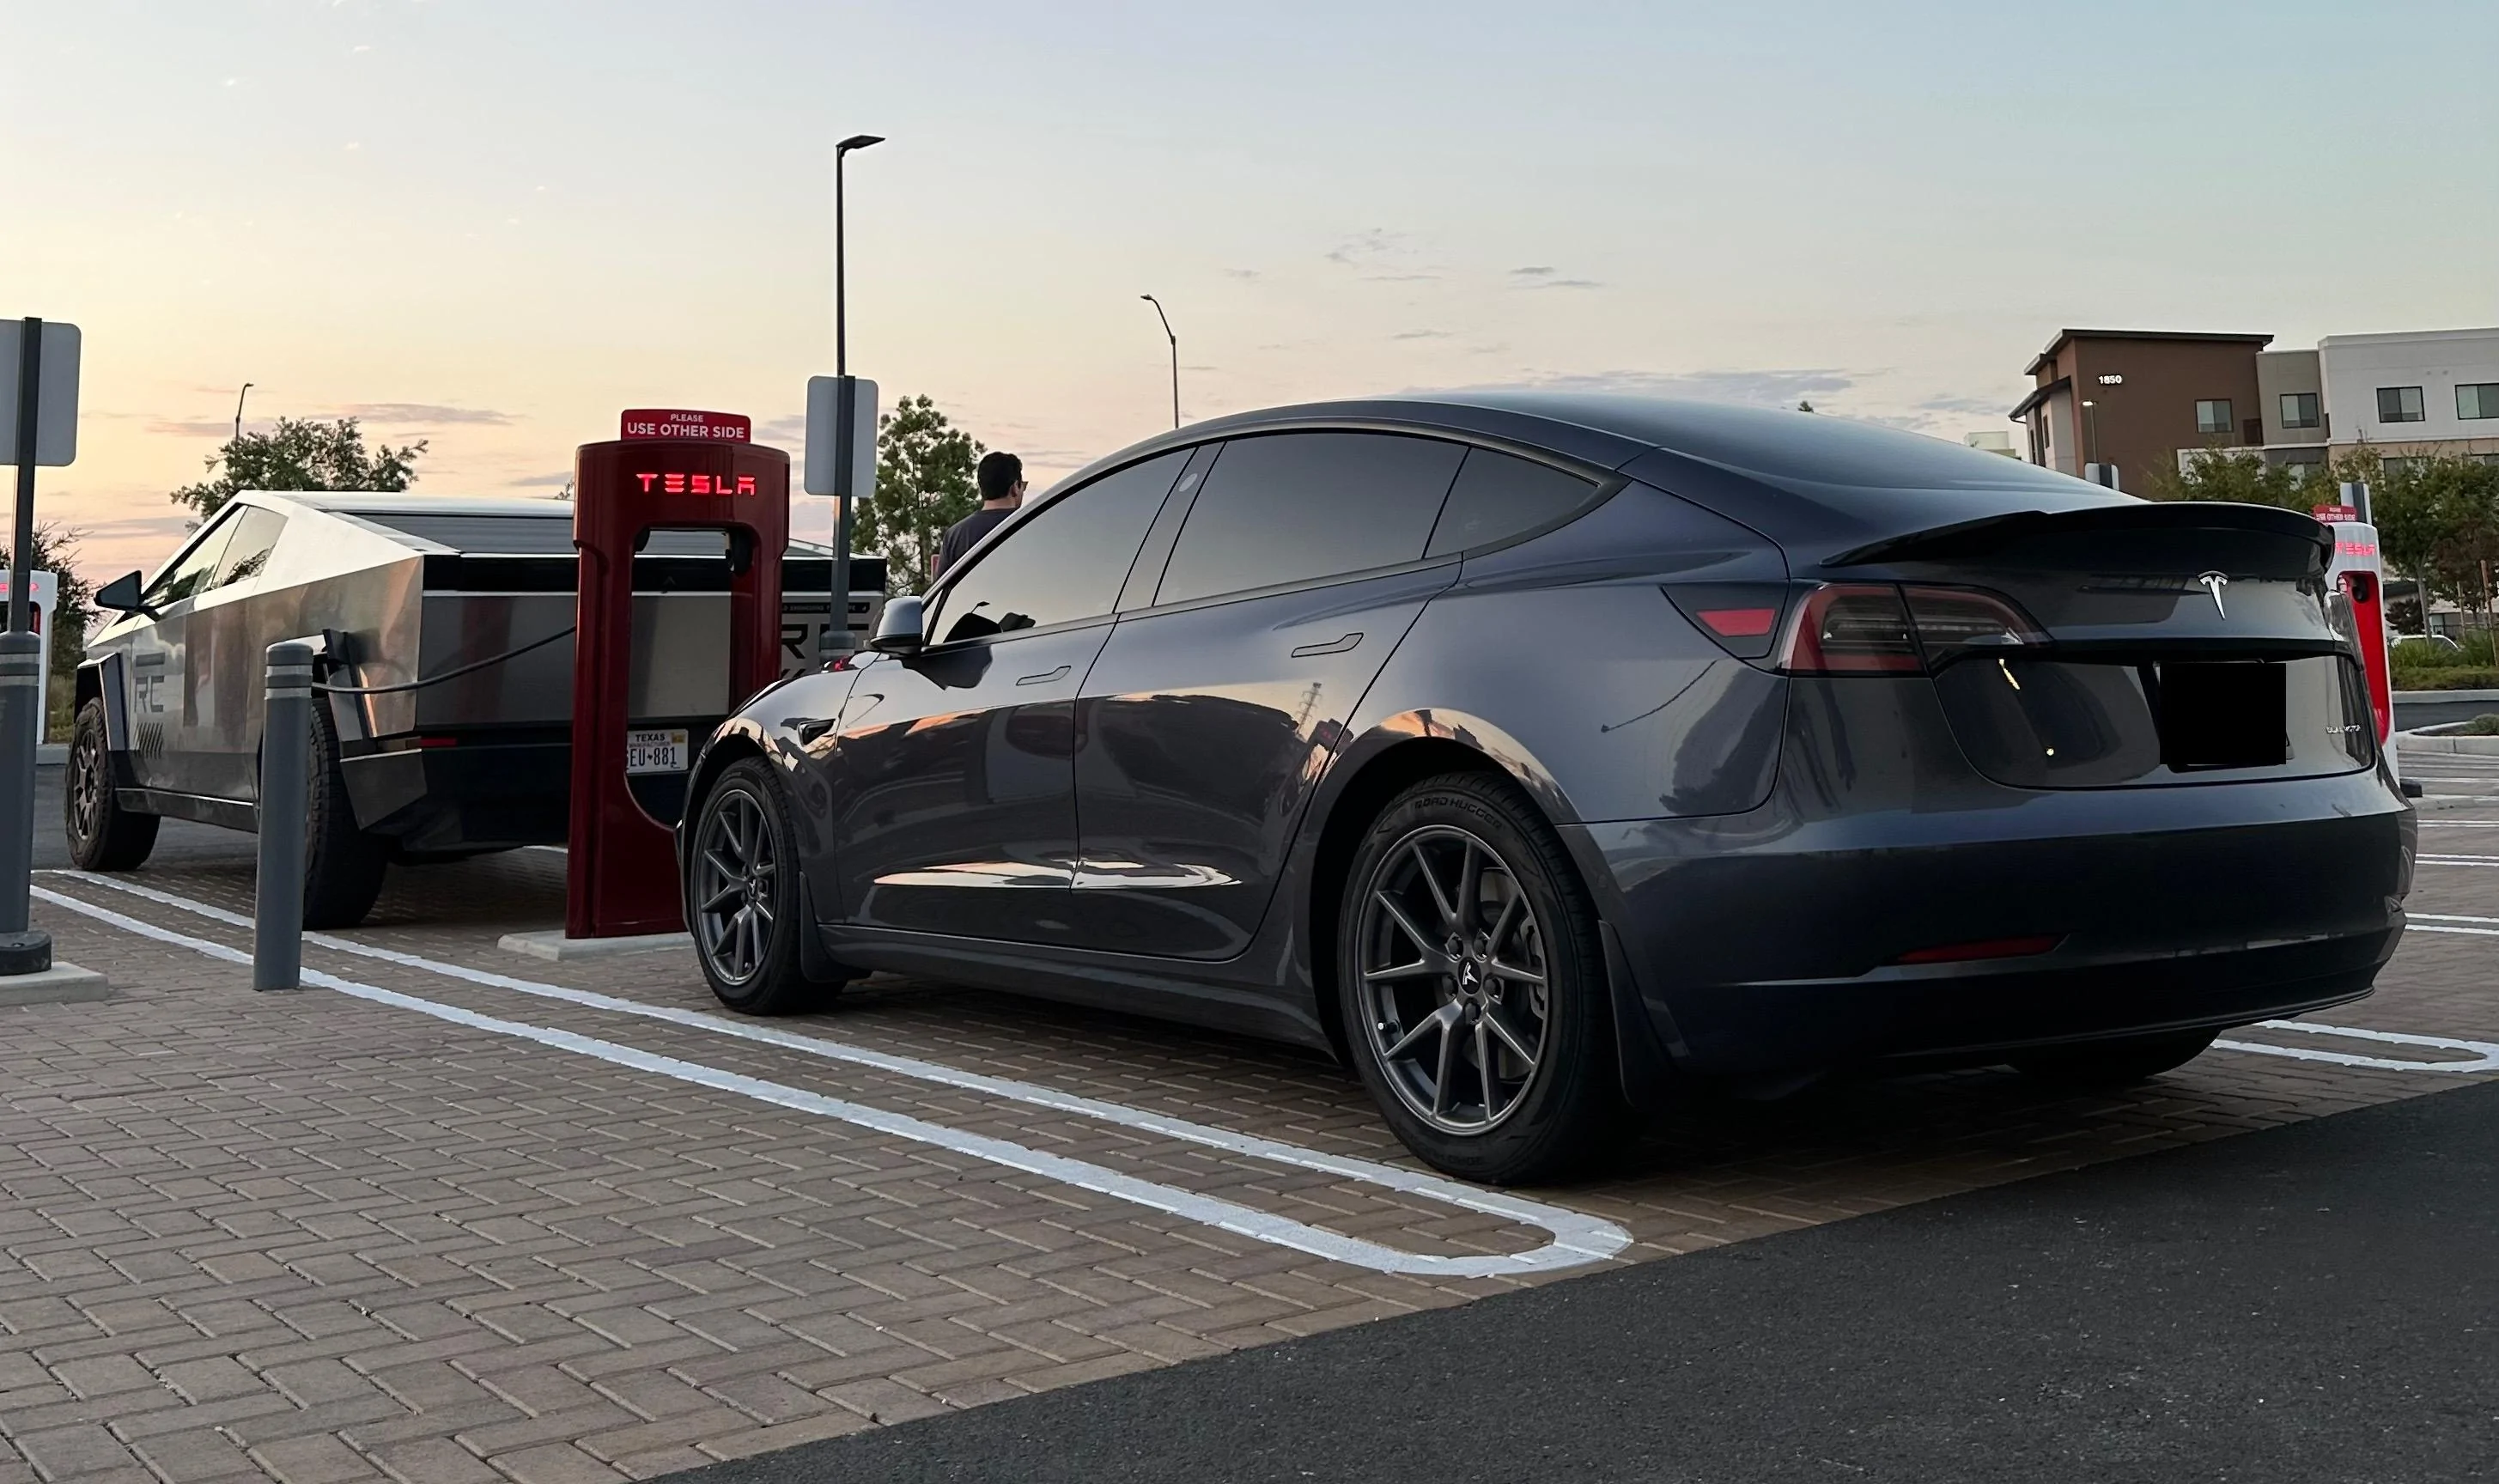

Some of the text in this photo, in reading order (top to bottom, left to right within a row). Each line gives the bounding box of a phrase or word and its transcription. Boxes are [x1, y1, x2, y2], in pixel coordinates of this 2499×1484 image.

[2099, 375, 2122, 384] 1850
[628, 423, 745, 438] USE OTHER SIDE
[635, 473, 756, 496] TESLA
[635, 733, 666, 742] TEXAS
